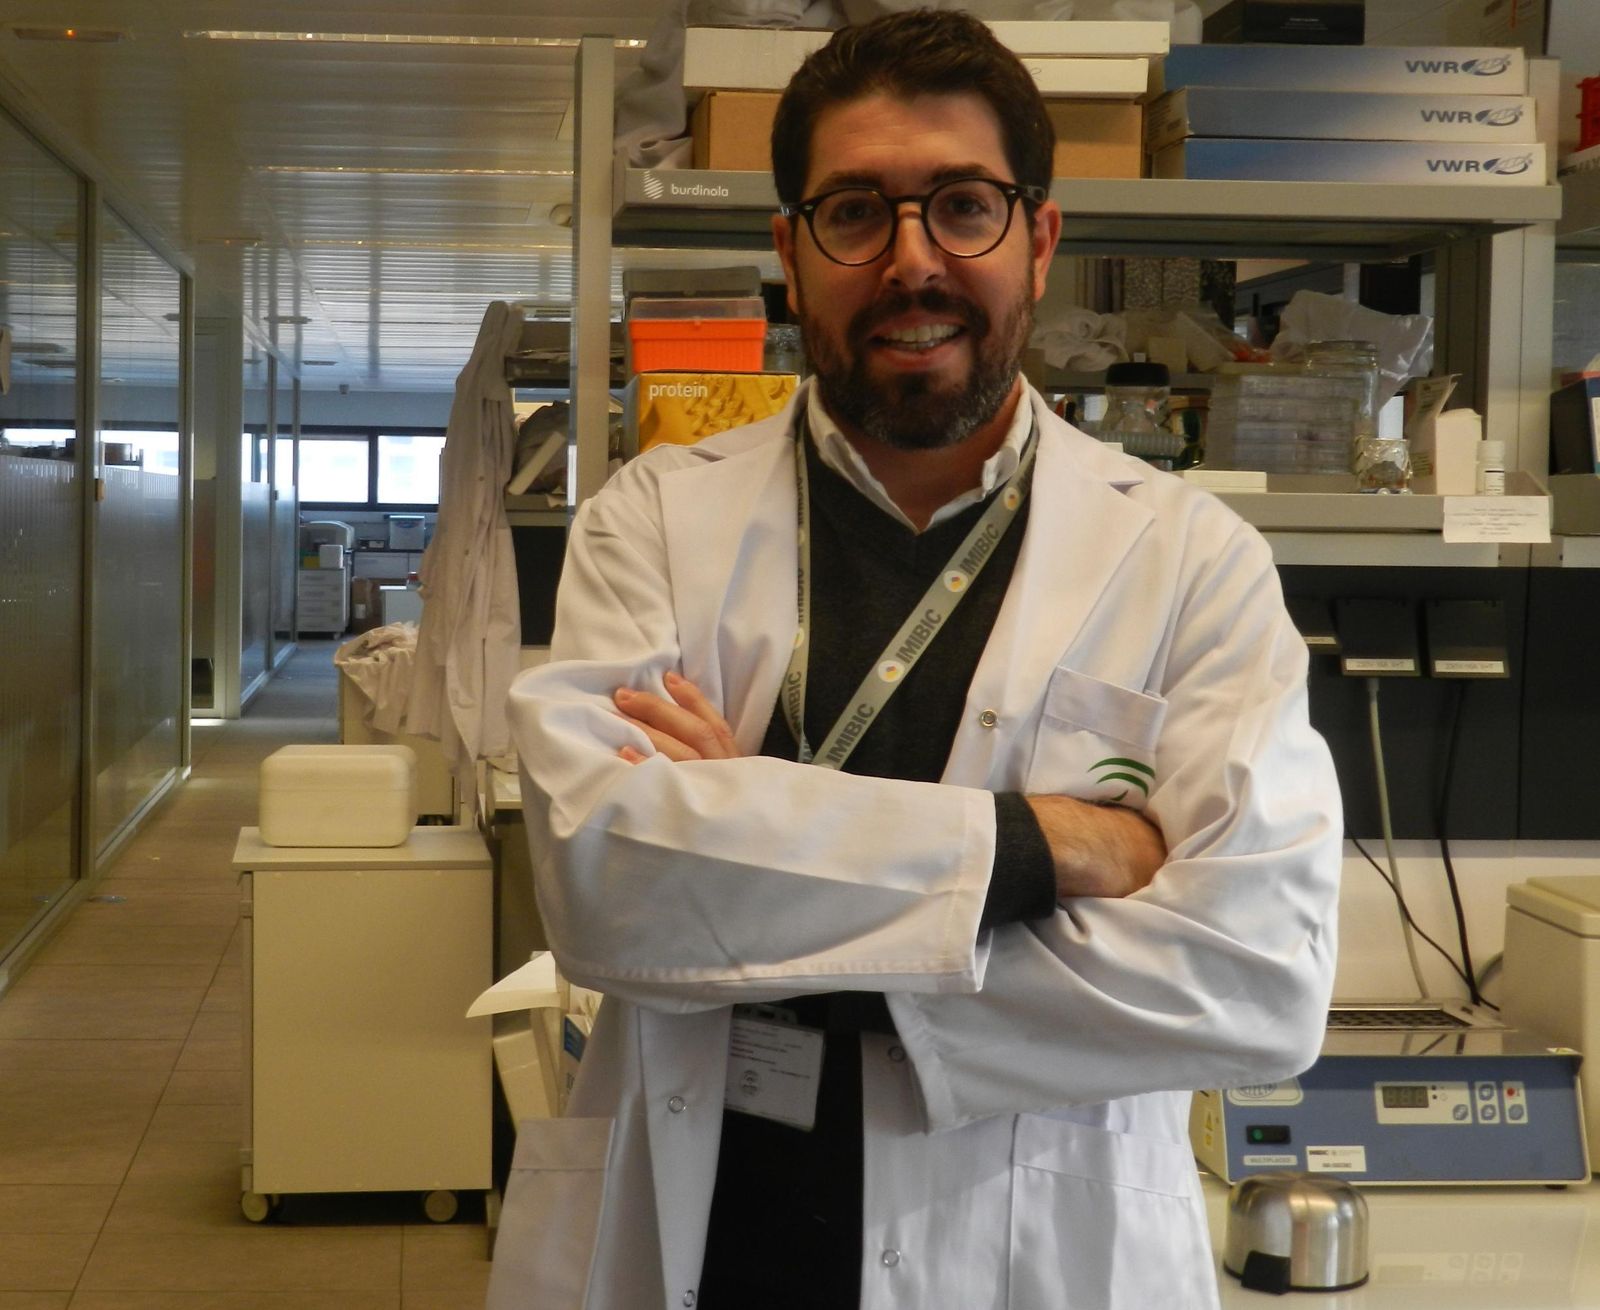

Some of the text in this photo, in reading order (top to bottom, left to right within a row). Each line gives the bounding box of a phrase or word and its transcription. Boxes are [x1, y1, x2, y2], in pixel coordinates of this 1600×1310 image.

[1405, 60, 1459, 73] VWR
[1420, 109, 1472, 123] VWR
[1426, 159, 1480, 173] VWR
[671, 183, 729, 197] burdinola
[649, 381, 708, 400] protein
[959, 523, 999, 576] IMIBIC
[896, 609, 942, 665] IMIBIC
[825, 703, 875, 763] IMIBIC
